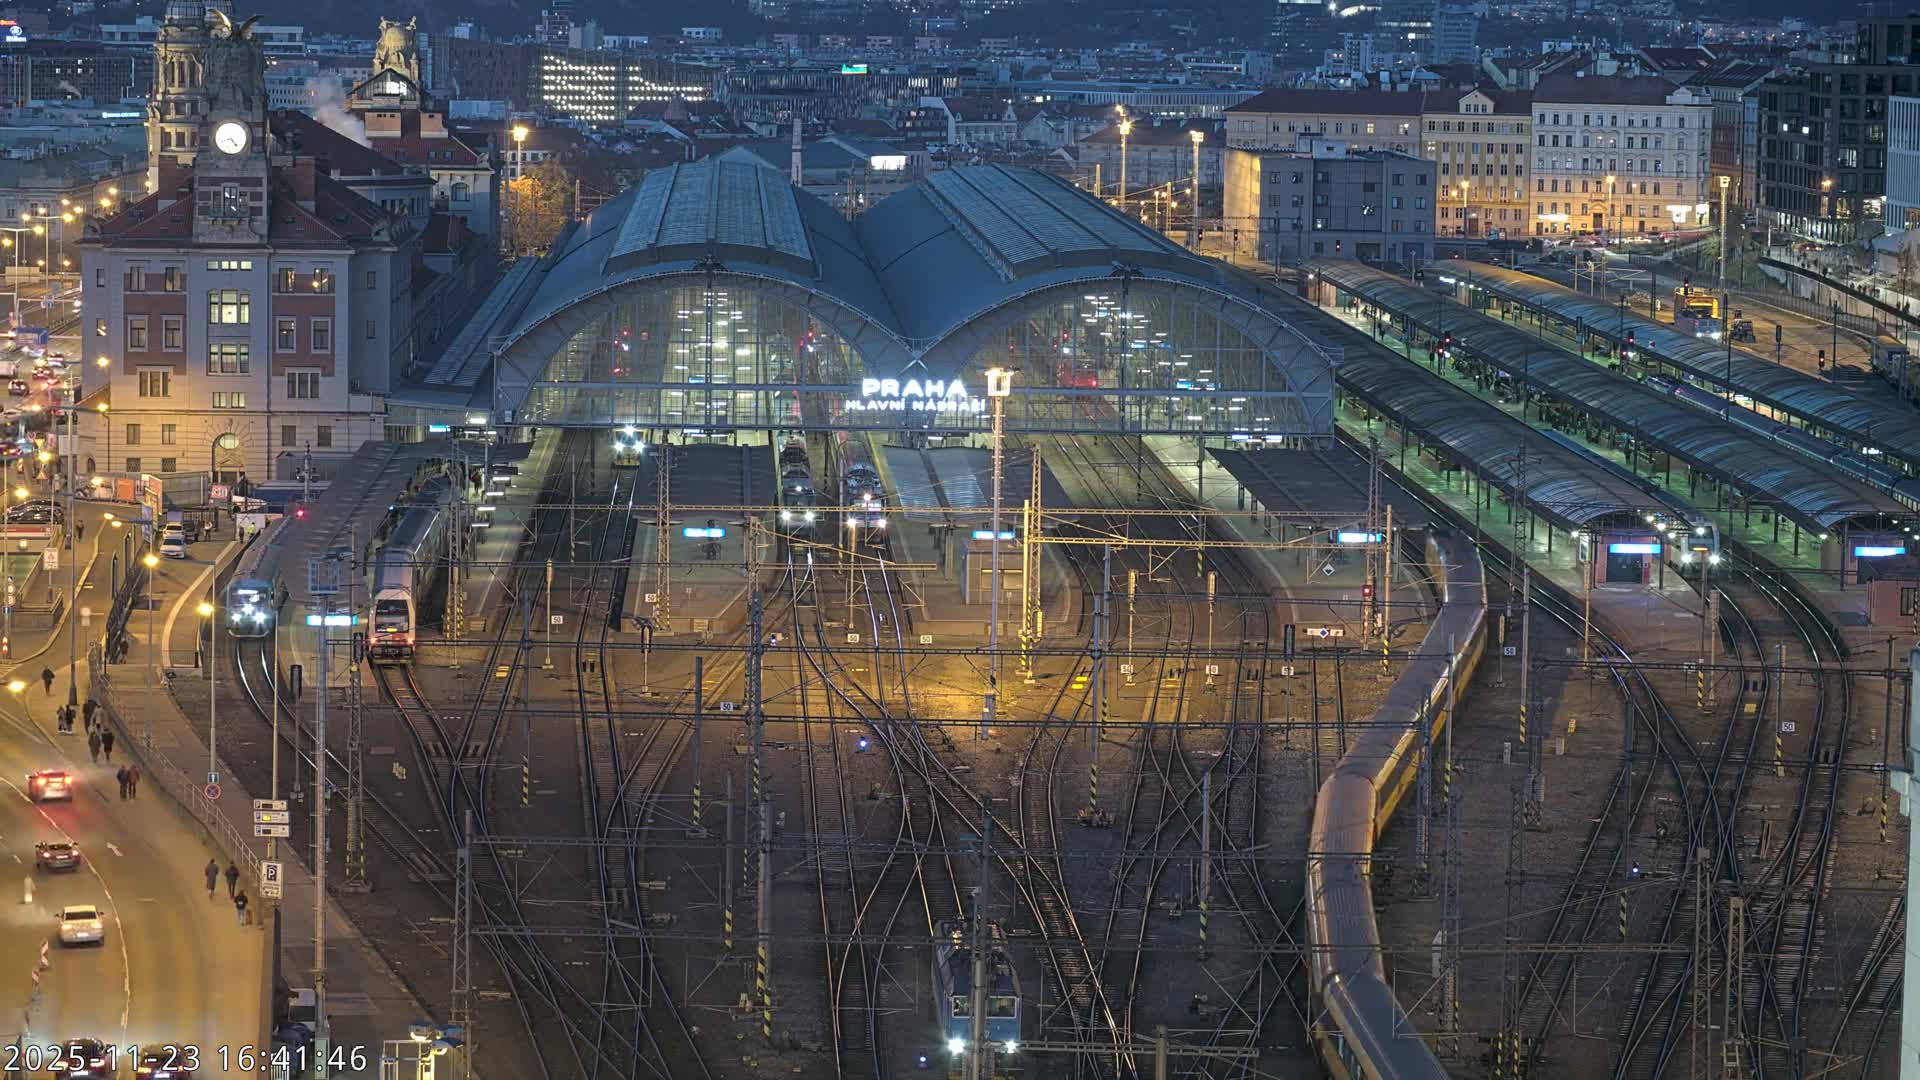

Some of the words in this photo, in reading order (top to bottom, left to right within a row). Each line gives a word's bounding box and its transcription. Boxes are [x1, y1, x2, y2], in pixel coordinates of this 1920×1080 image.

[863, 378, 967, 397] PRAHA
[845, 398, 905, 410] HLAVNÍ
[553, 616, 561, 624] 50
[1784, 723, 1793, 731] 50
[268, 869, 276, 879] P
